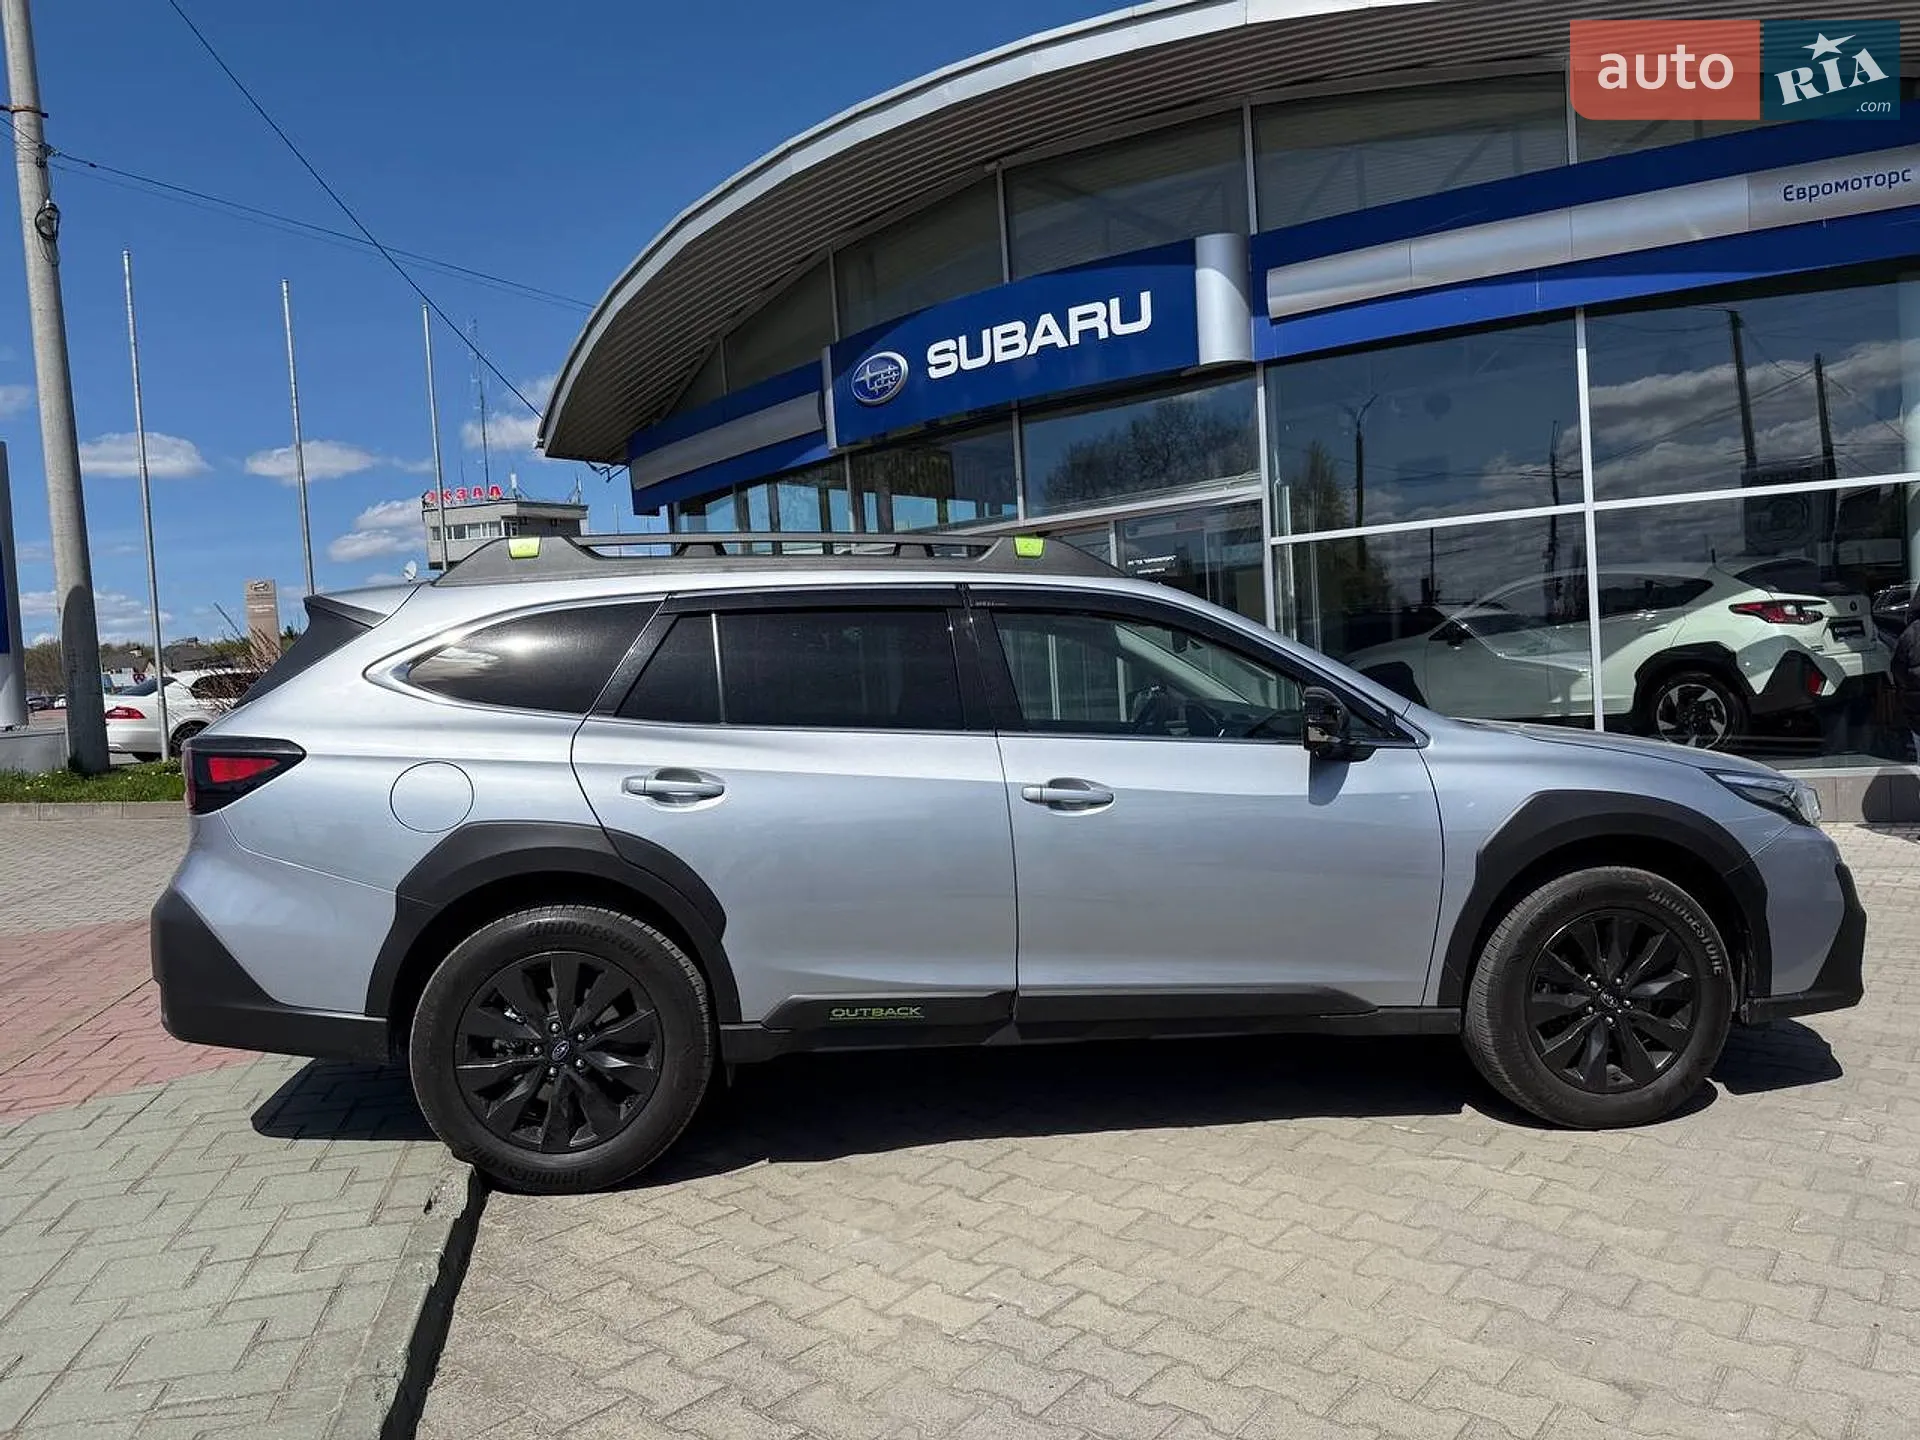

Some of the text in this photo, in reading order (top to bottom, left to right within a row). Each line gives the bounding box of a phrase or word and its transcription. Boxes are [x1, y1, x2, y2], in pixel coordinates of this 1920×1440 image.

[1783, 168, 1912, 203] Євромоторс
[926, 290, 1152, 380] SUBARU
[831, 1006, 922, 1018] OUTBACK
